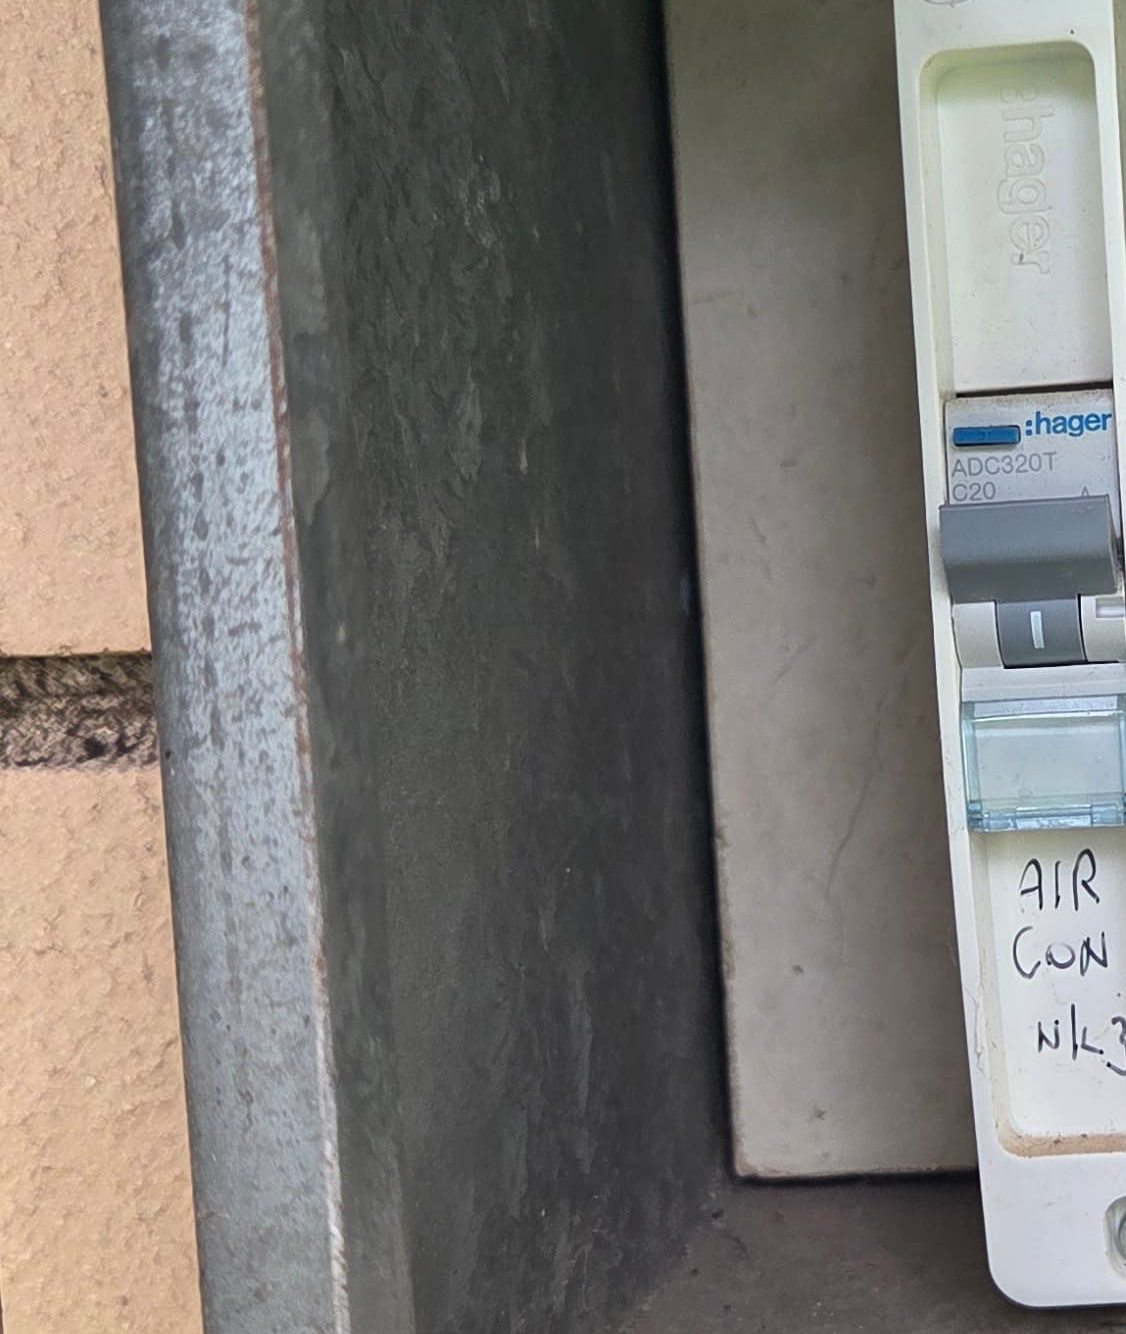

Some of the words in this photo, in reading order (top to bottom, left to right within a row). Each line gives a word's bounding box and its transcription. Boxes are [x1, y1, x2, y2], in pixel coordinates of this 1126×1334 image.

[951, 451, 1058, 477] ADC320T
[952, 482, 996, 502] C20
[1019, 848, 1100, 912] AIR
[1012, 925, 1108, 979] CON
